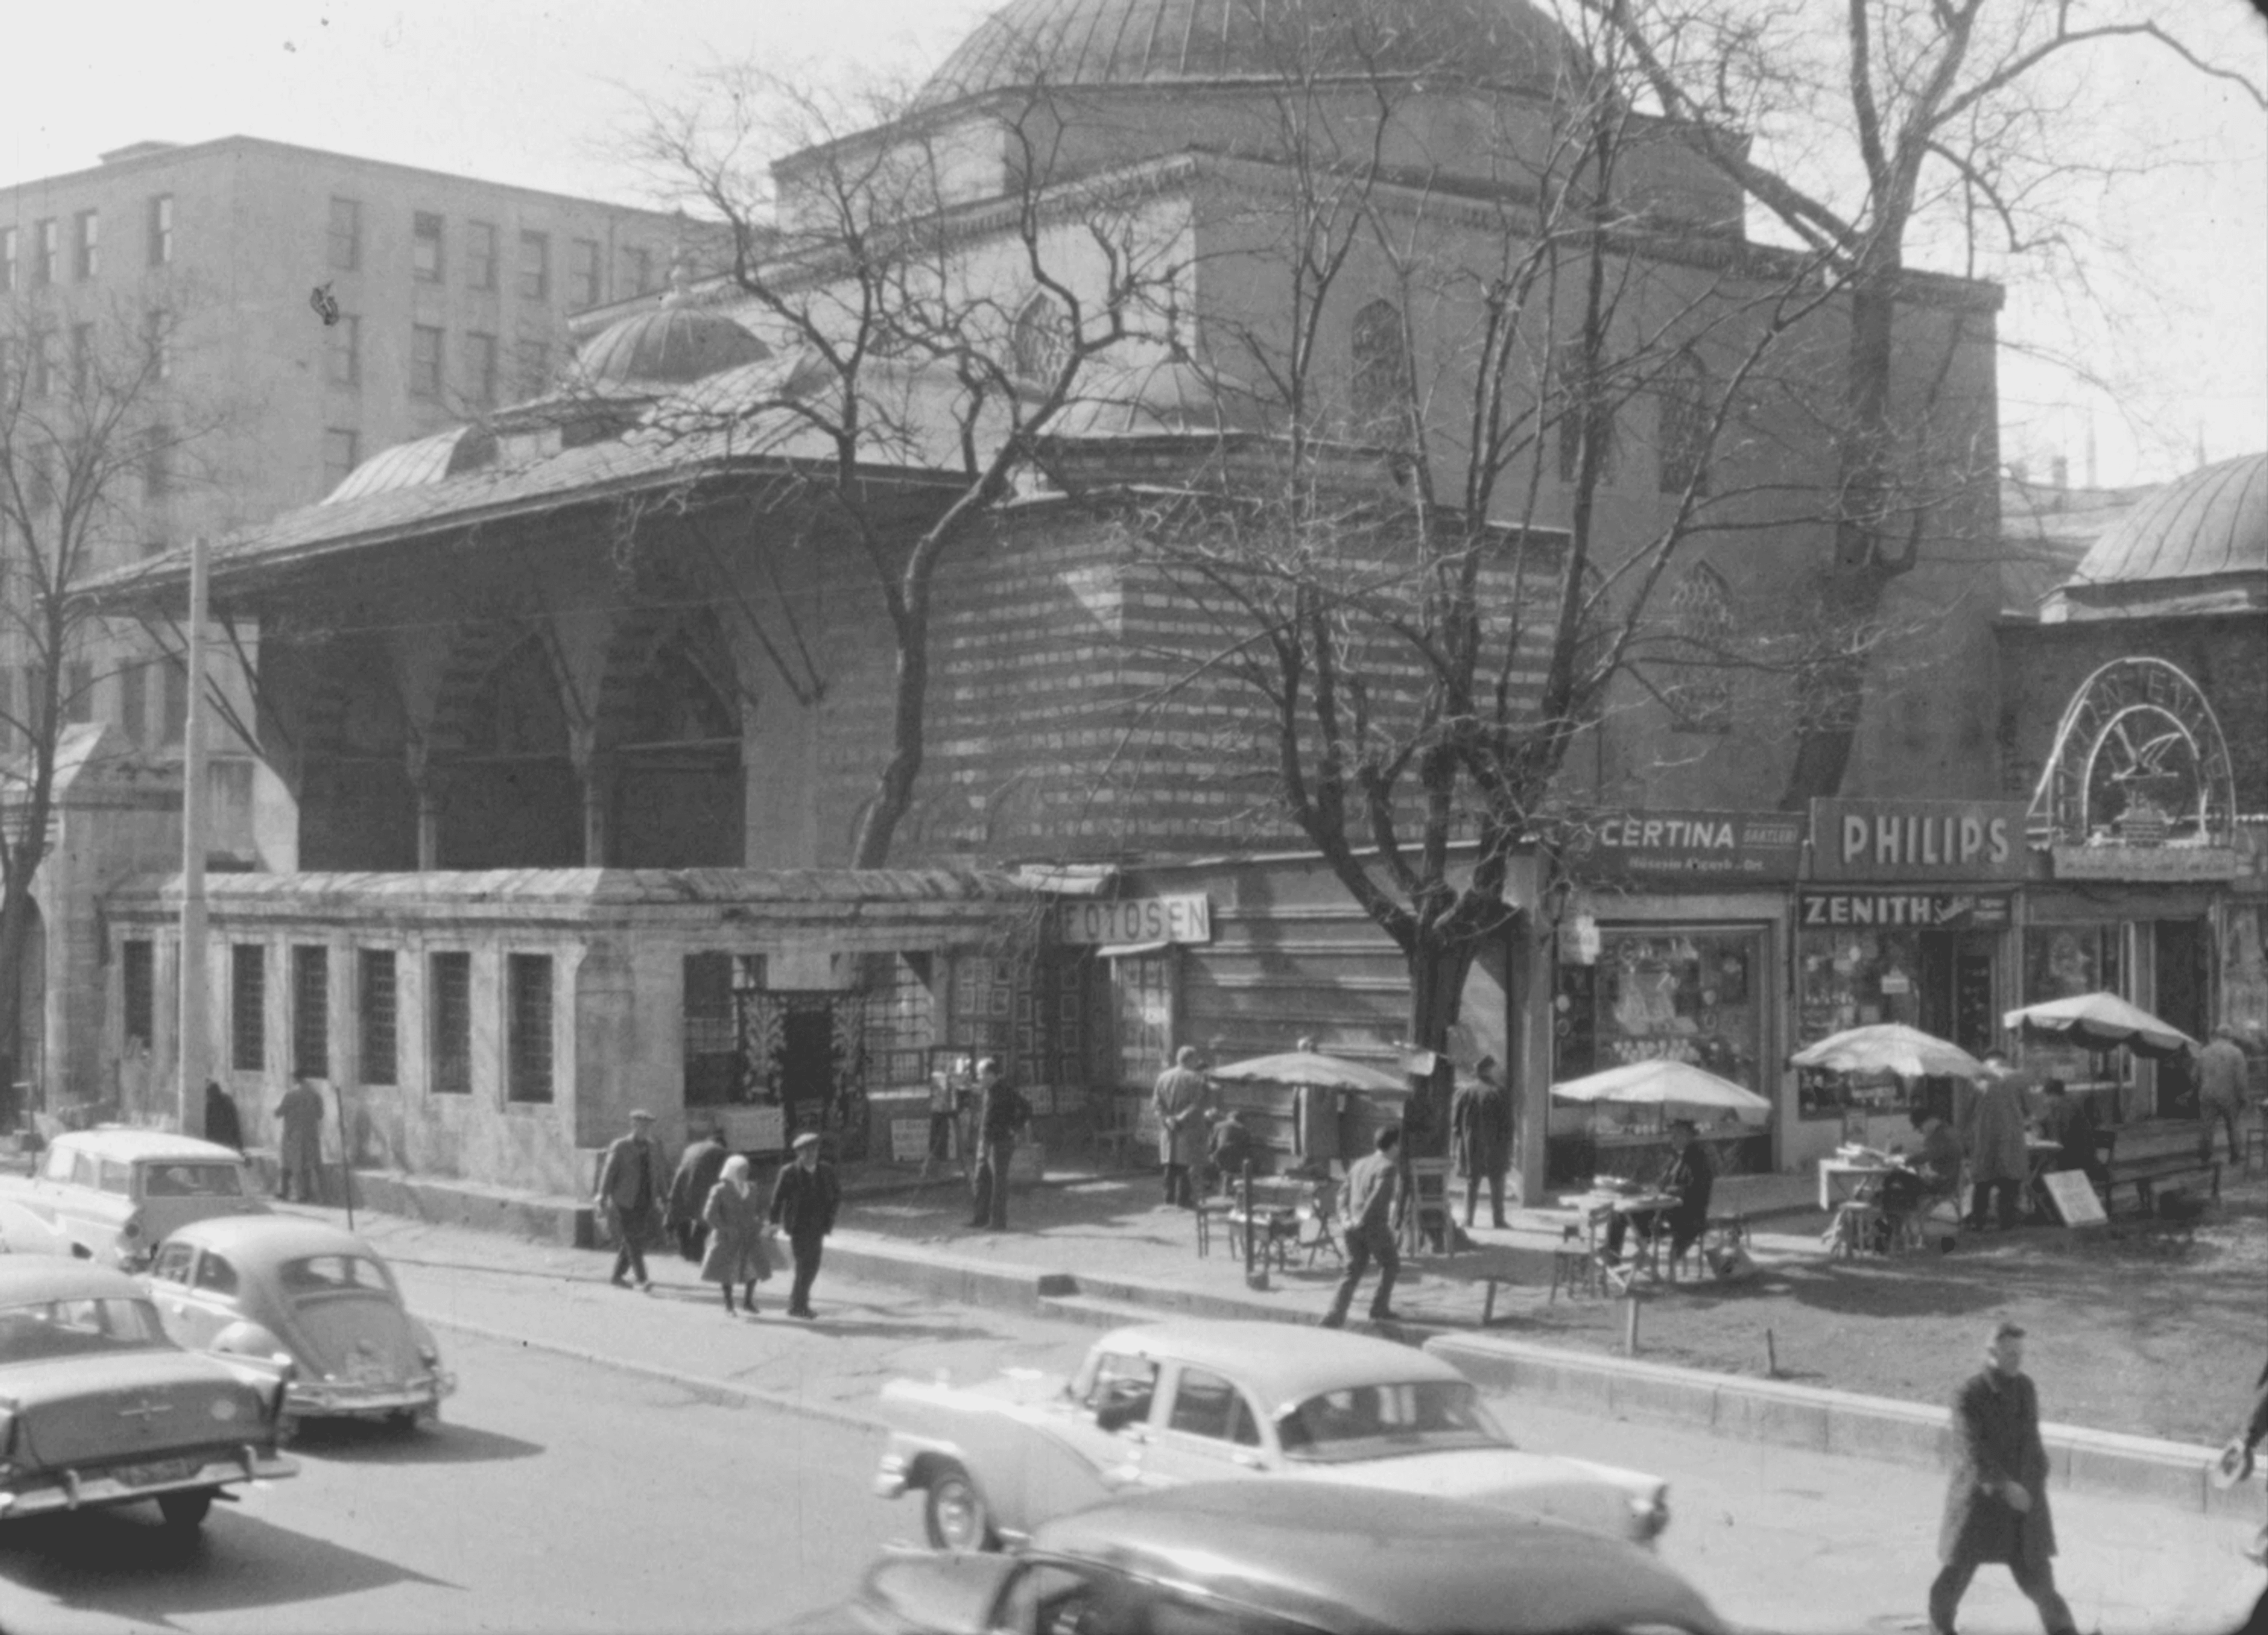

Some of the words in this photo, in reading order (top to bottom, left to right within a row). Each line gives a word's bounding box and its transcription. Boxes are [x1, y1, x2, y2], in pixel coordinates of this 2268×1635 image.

[1601, 820, 1734, 848] CERTINA
[1843, 815, 2008, 864] PHILIPS
[1065, 900, 1207, 939] FOTOSEN
[1804, 897, 1930, 923] ZENITH
